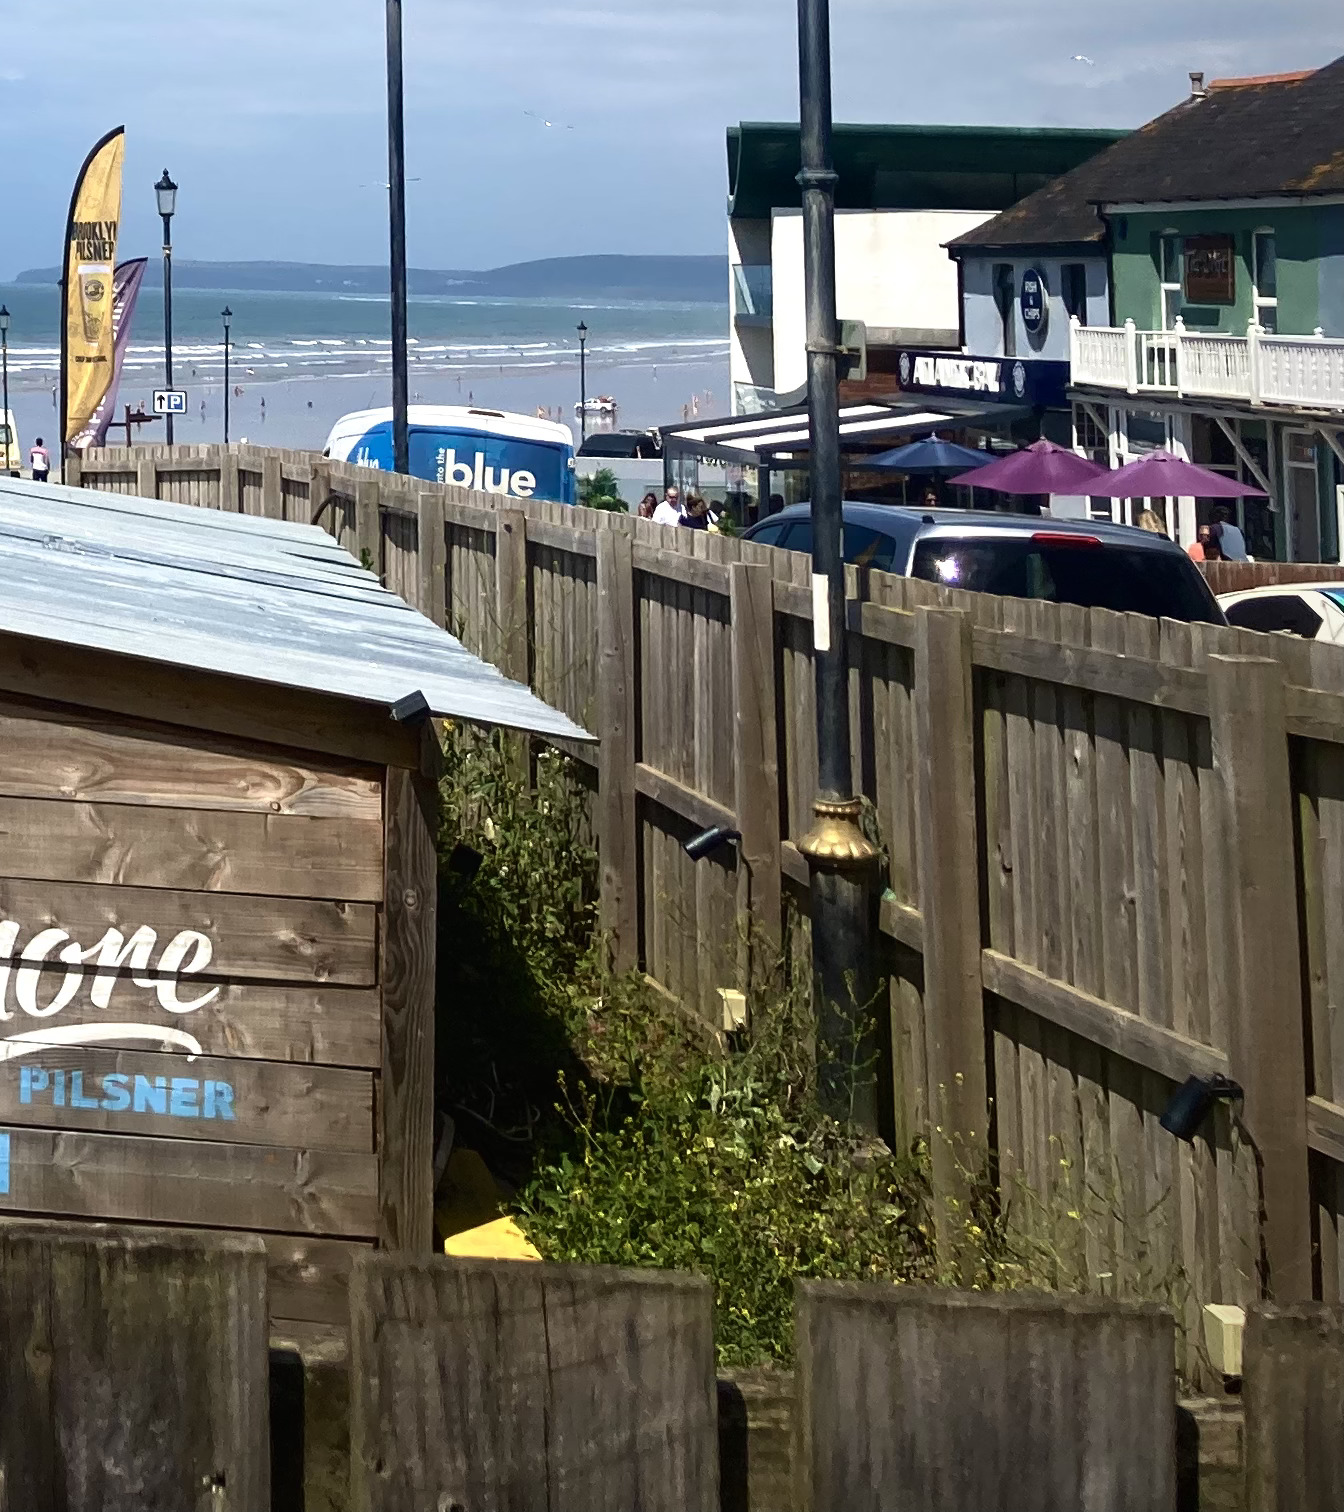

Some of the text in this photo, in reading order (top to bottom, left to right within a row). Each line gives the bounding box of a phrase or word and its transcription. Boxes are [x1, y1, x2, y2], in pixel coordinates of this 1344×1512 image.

[170, 395, 181, 409] P
[445, 448, 537, 498] blue
[19, 1065, 237, 1120] PILSNER
